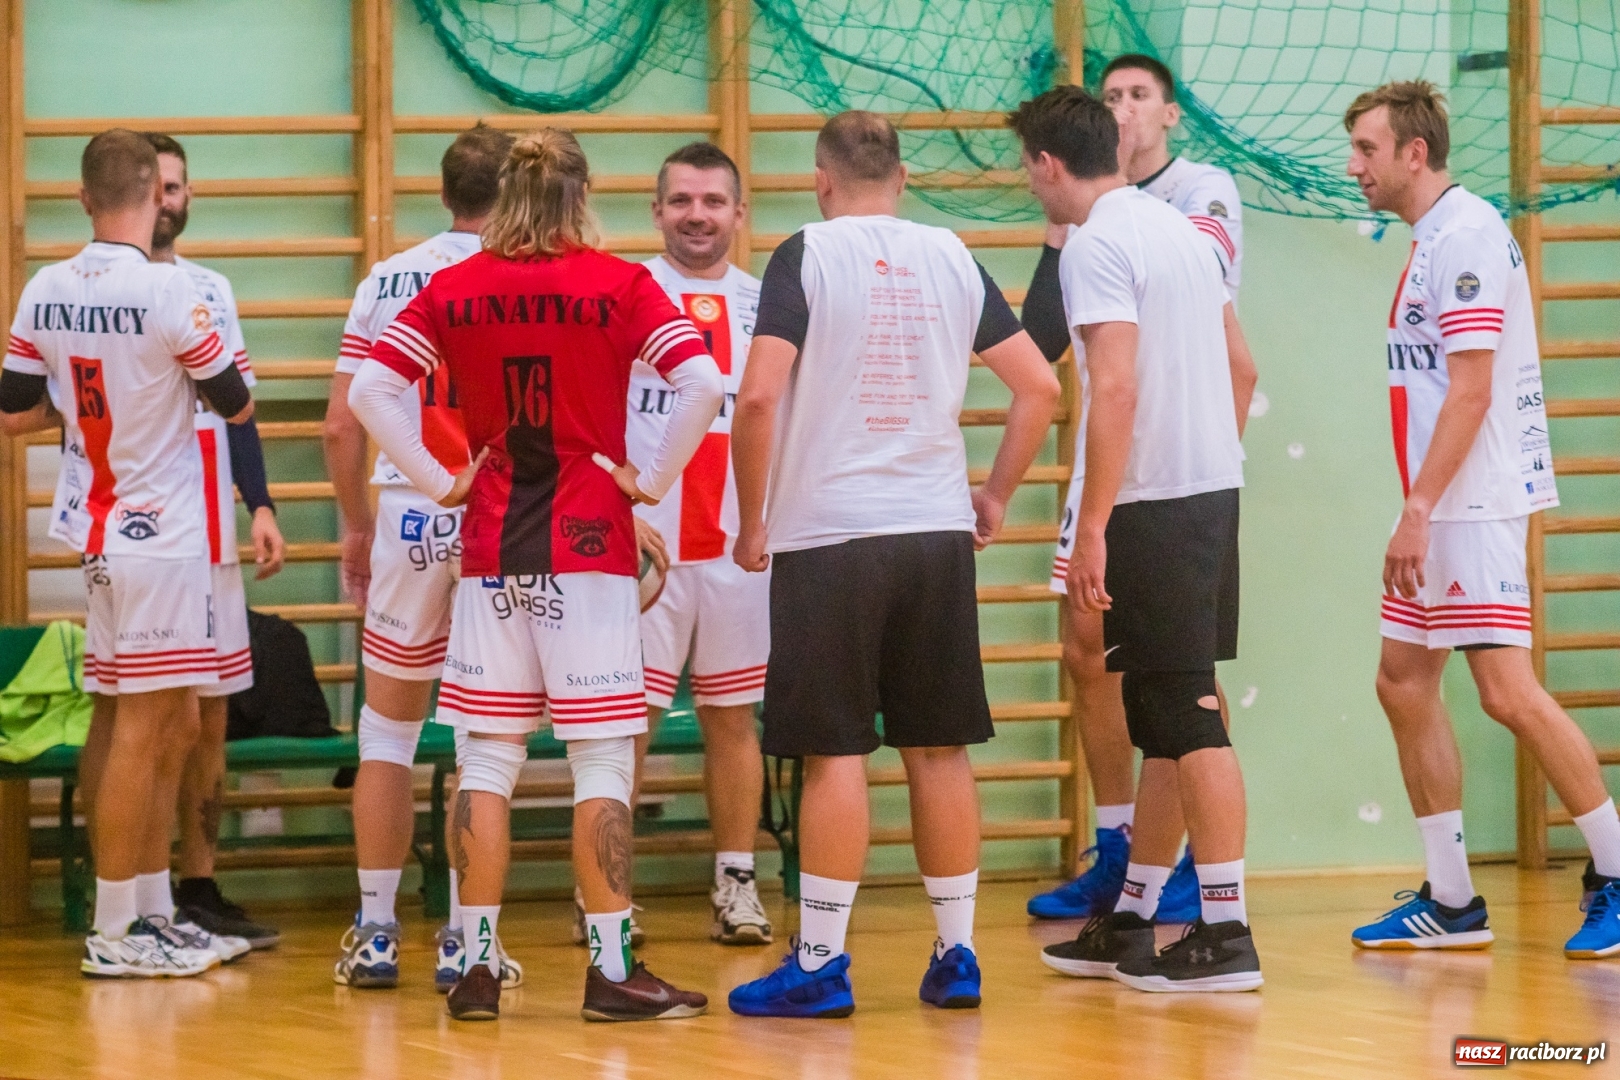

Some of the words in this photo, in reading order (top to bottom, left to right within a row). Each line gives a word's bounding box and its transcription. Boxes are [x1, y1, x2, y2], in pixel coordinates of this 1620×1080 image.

[33, 303, 148, 335] LUNATYCY
[445, 294, 617, 329] LUNATYCY
[71, 362, 105, 420] 15
[504, 361, 549, 430] 16
[492, 584, 564, 621] glass
